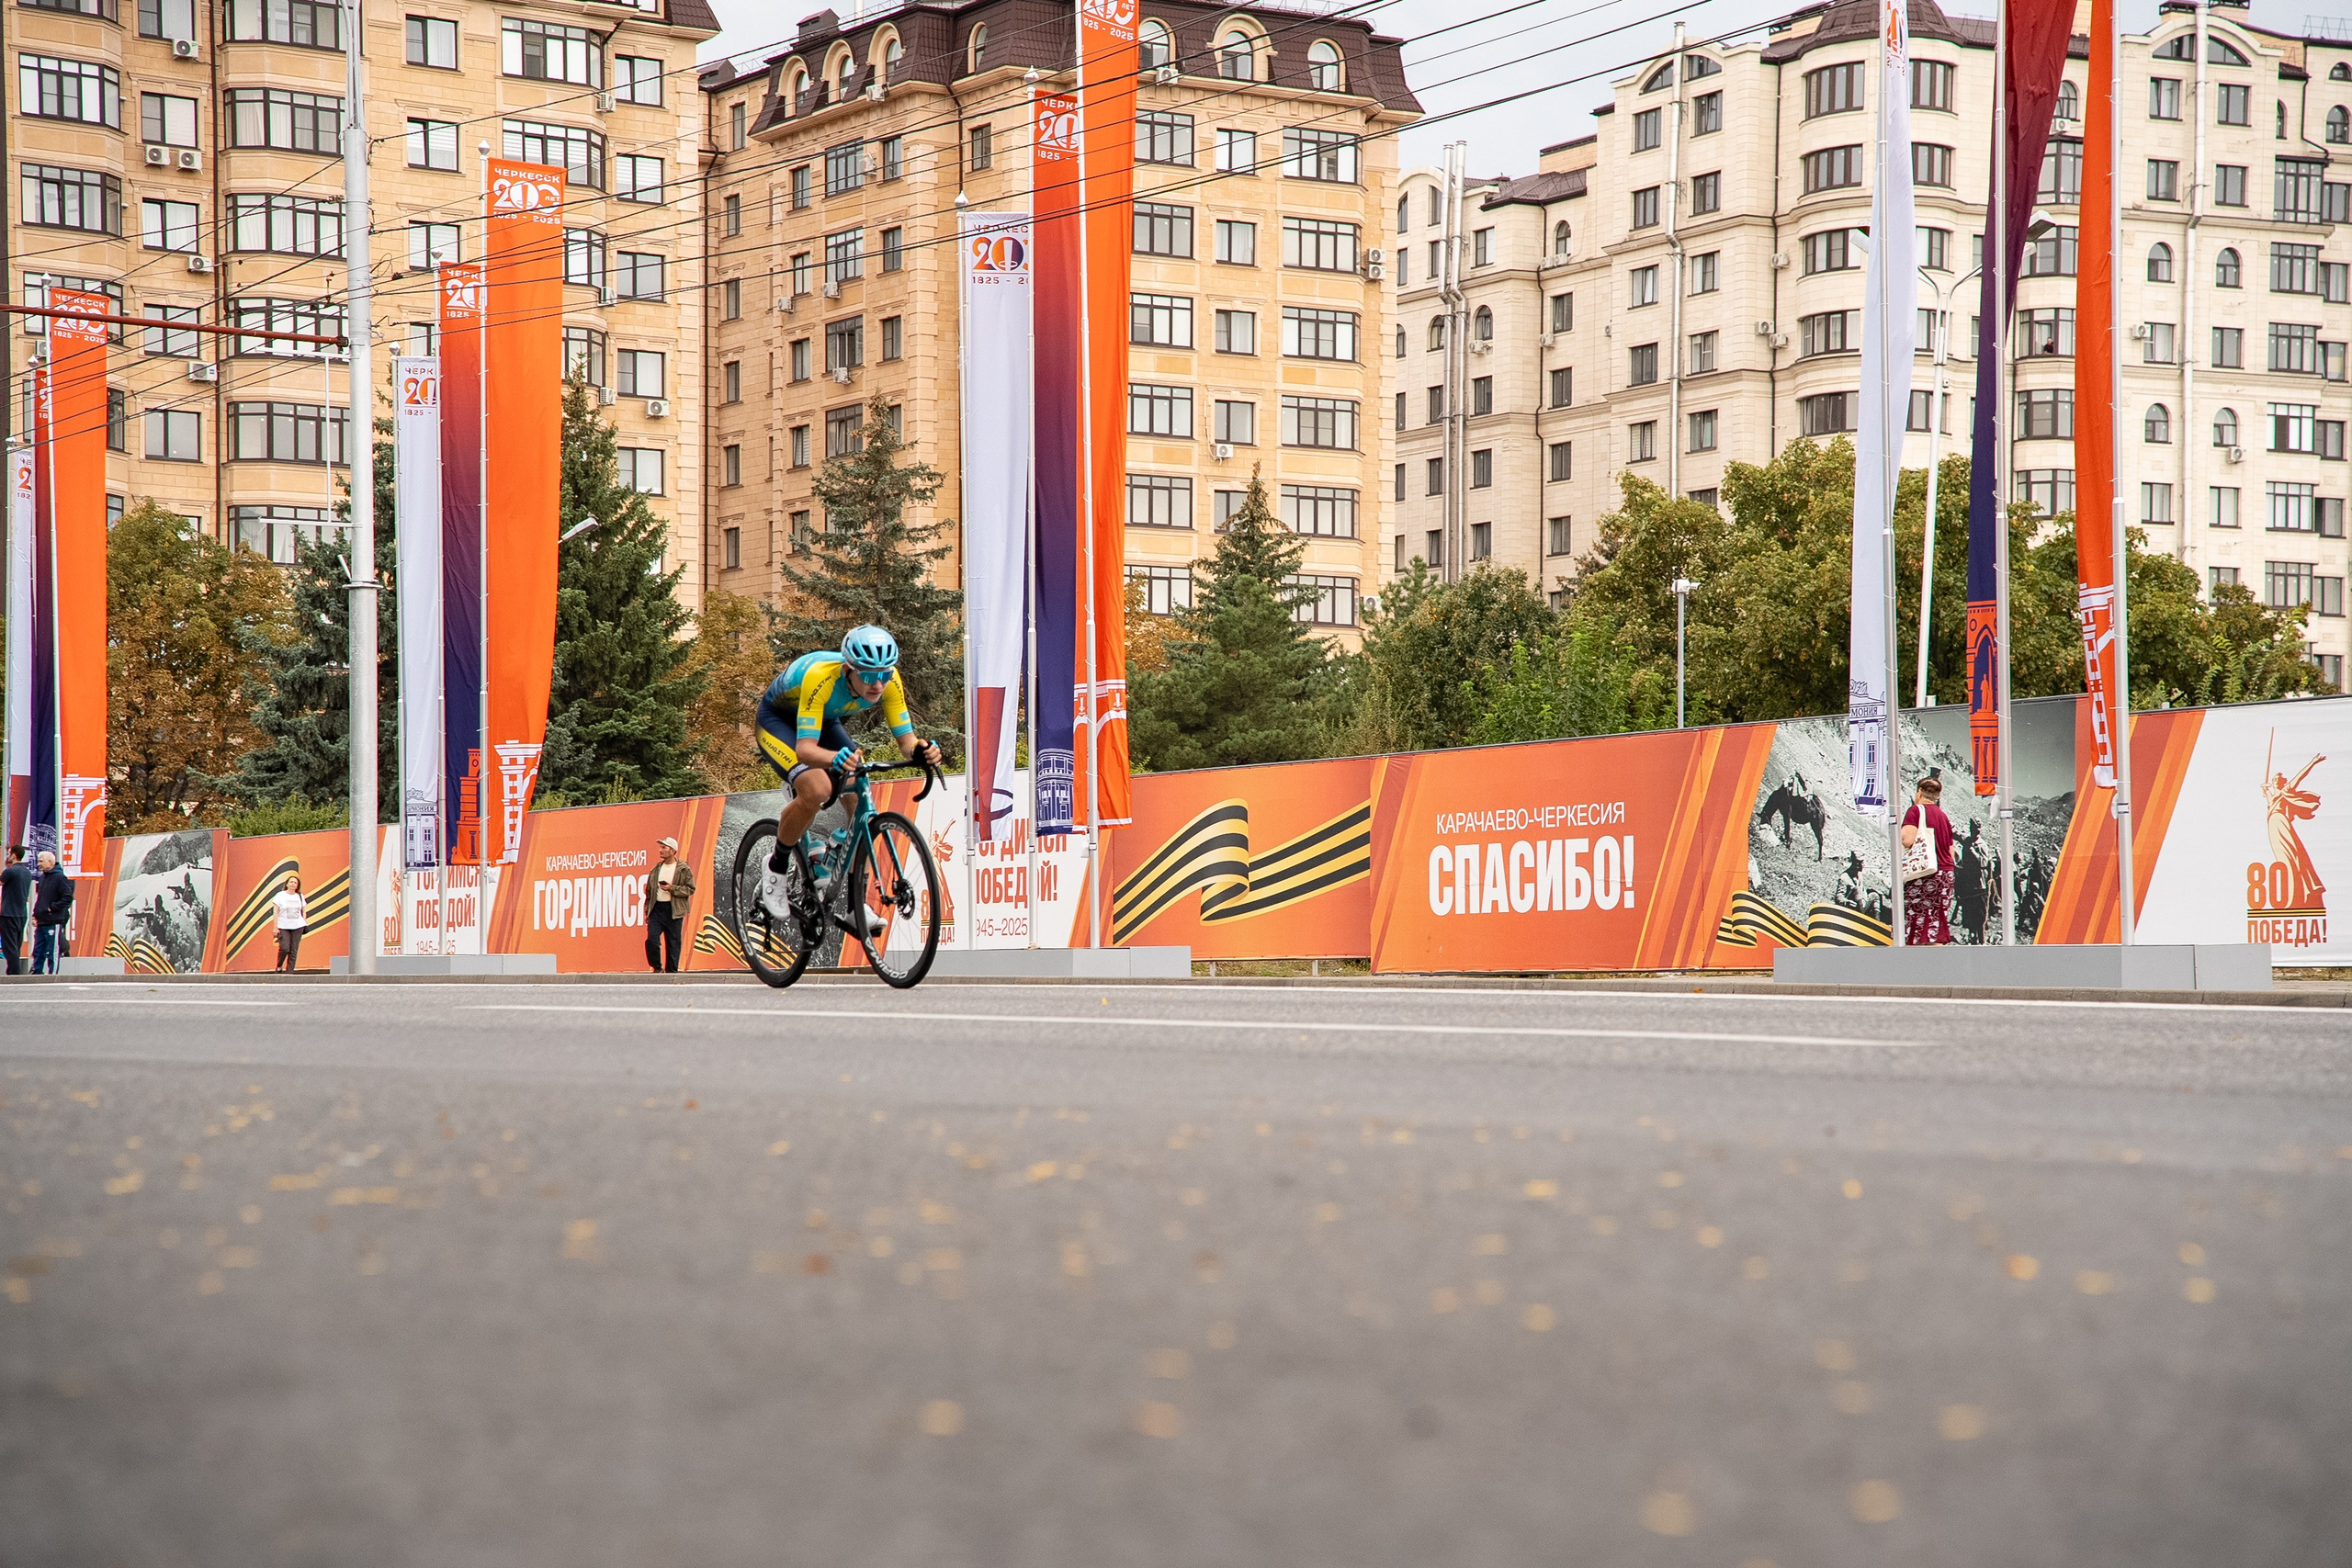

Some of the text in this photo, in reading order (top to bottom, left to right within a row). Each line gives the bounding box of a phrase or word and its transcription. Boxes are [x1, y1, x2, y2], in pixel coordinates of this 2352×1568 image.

[1084, 17, 1099, 30] 825
[1110, 28, 1134, 40] 2025
[1042, 98, 1079, 111] ЧЕРК
[1039, 110, 1079, 149] 20
[494, 167, 560, 184] ЧЕРКЕССК
[493, 178, 560, 214] 200
[533, 215, 560, 225] 2025
[972, 236, 1028, 272] 20
[447, 269, 481, 280] ЧЕРК
[972, 276, 1000, 285] 1825
[55, 293, 106, 309] ЧЕРКЕССК
[446, 279, 486, 310] 20
[53, 330, 73, 339] 1825
[84, 334, 106, 344] 2025
[404, 378, 436, 405] 20
[1850, 706, 1878, 717] МОНИЯ
[1436, 801, 1625, 835] КАРАЧАЕВО-ЧЕРКЕСИЯ
[546, 850, 647, 872] КАРАЧАЕВО-ЧЕРКЕСИЯ
[976, 860, 1057, 909] ОБЕДЙ!
[1429, 835, 1635, 917] СПАСИБО!
[2247, 862, 2289, 909] 80
[416, 893, 476, 933] ПОБДОЙ!
[2247, 919, 2327, 948] ПОБЕДА!
[865, 936, 909, 979] CORIMA
